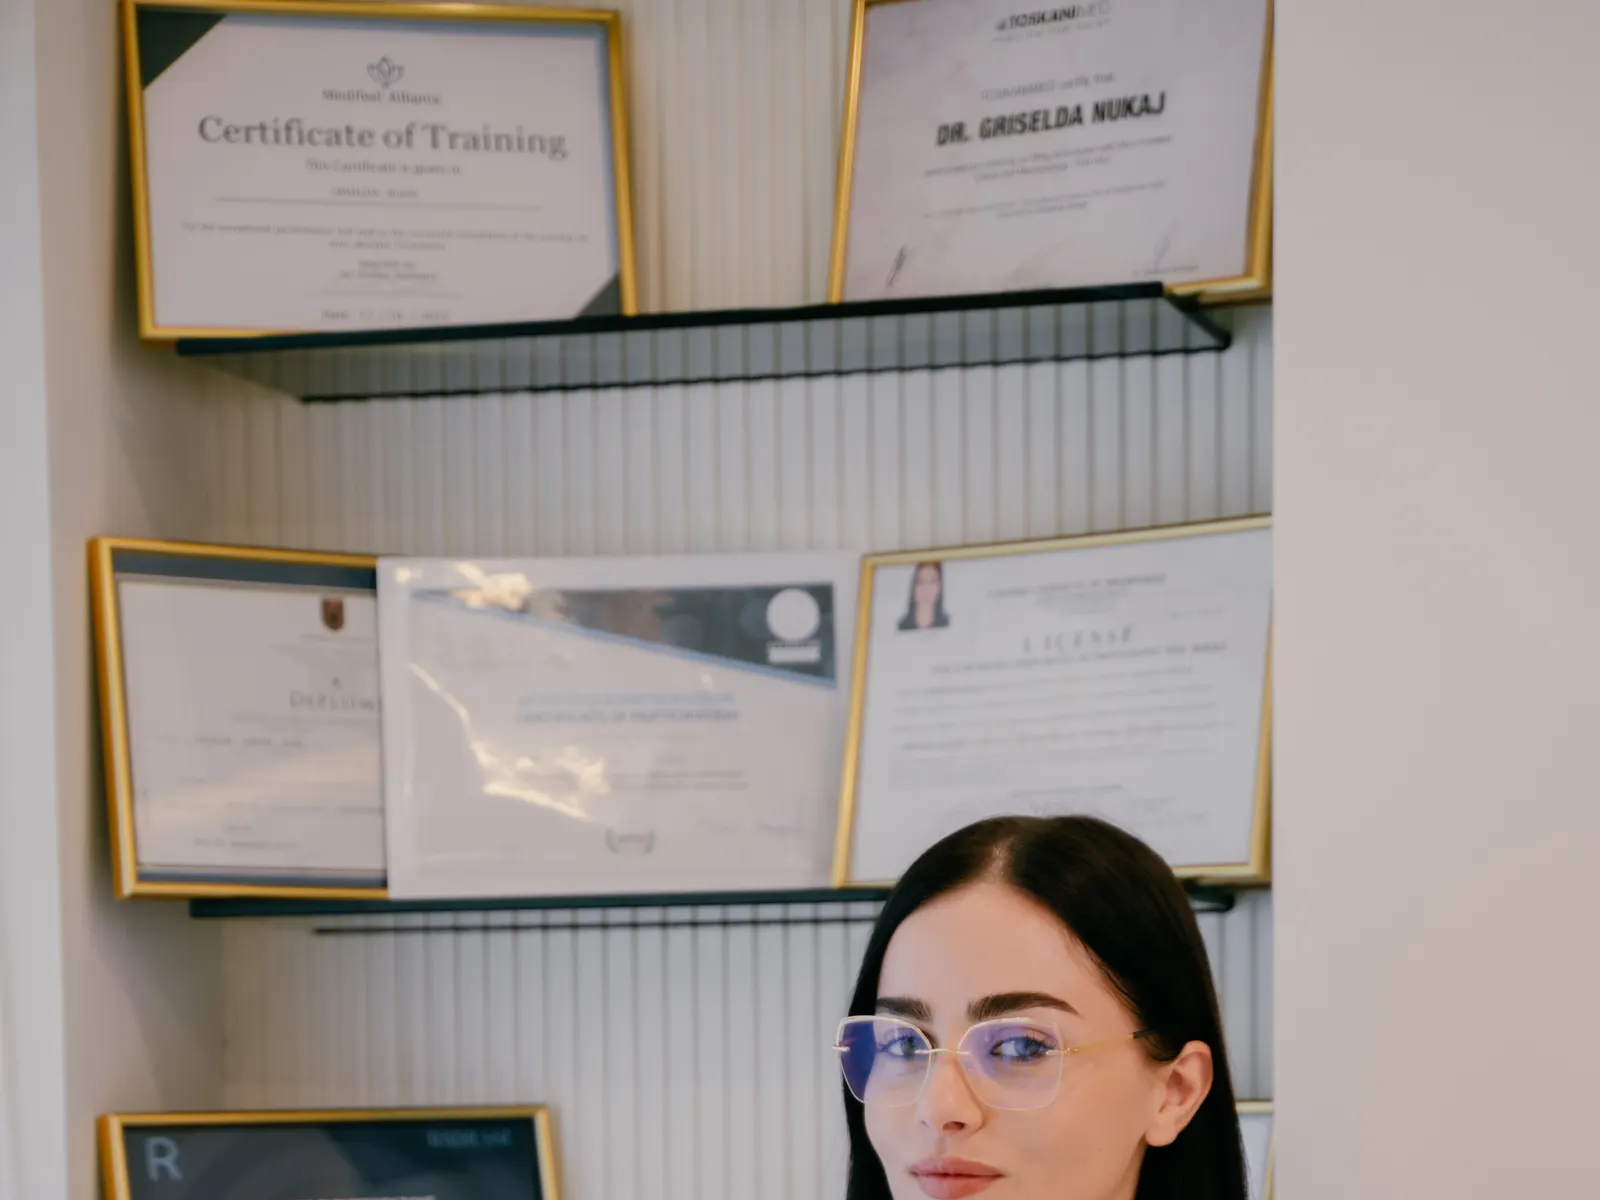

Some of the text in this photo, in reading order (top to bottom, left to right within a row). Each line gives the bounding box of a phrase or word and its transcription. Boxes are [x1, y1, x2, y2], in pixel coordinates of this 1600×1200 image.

[196, 114, 570, 160] Certificate of Training
[935, 91, 1168, 146] DR. GRISELDA NUKAJ
[145, 1137, 183, 1181] R
